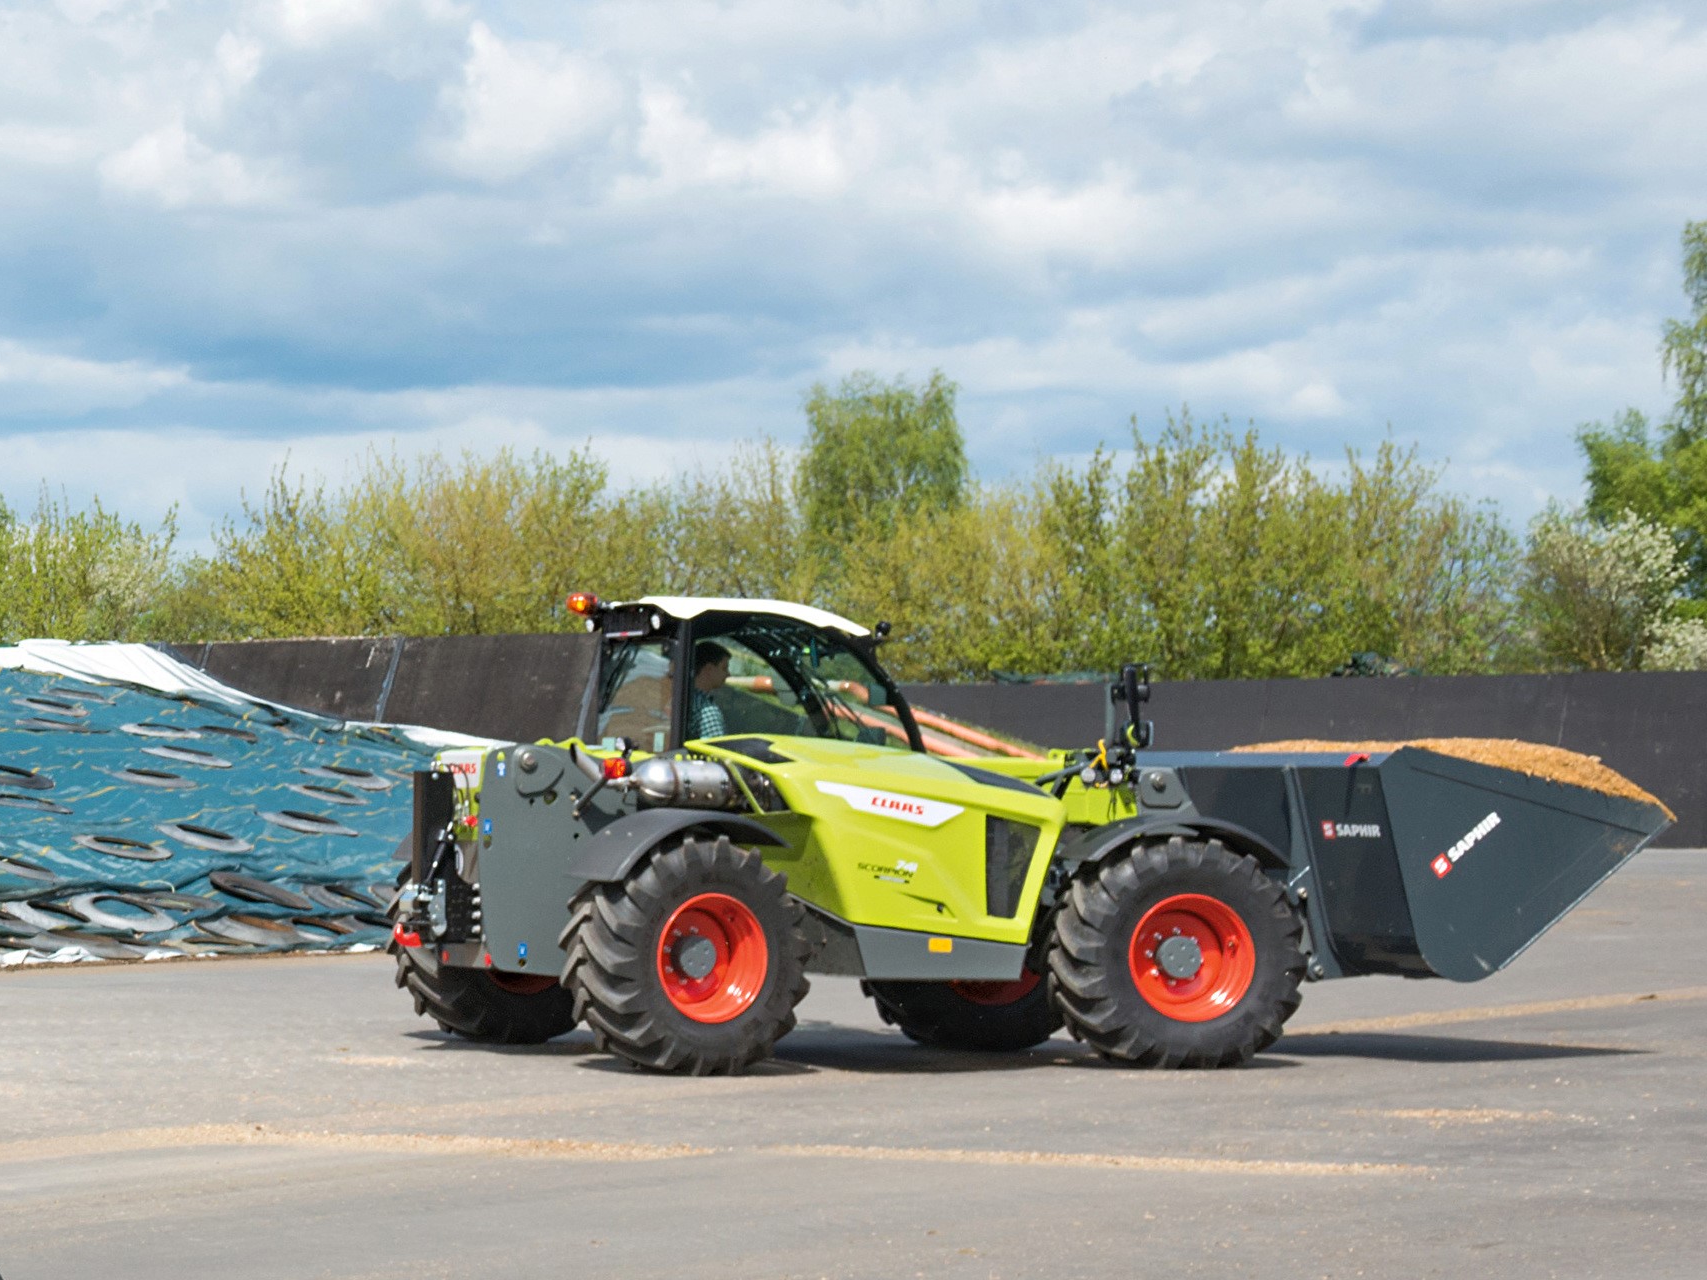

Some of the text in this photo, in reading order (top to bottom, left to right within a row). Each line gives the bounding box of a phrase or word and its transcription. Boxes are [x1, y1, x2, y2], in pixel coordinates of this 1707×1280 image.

[871, 797, 924, 815] CLAAS
[1336, 823, 1381, 838] SAPHIR
[1447, 811, 1501, 862] SAPHIR
[858, 862, 914, 878] SCORPION
